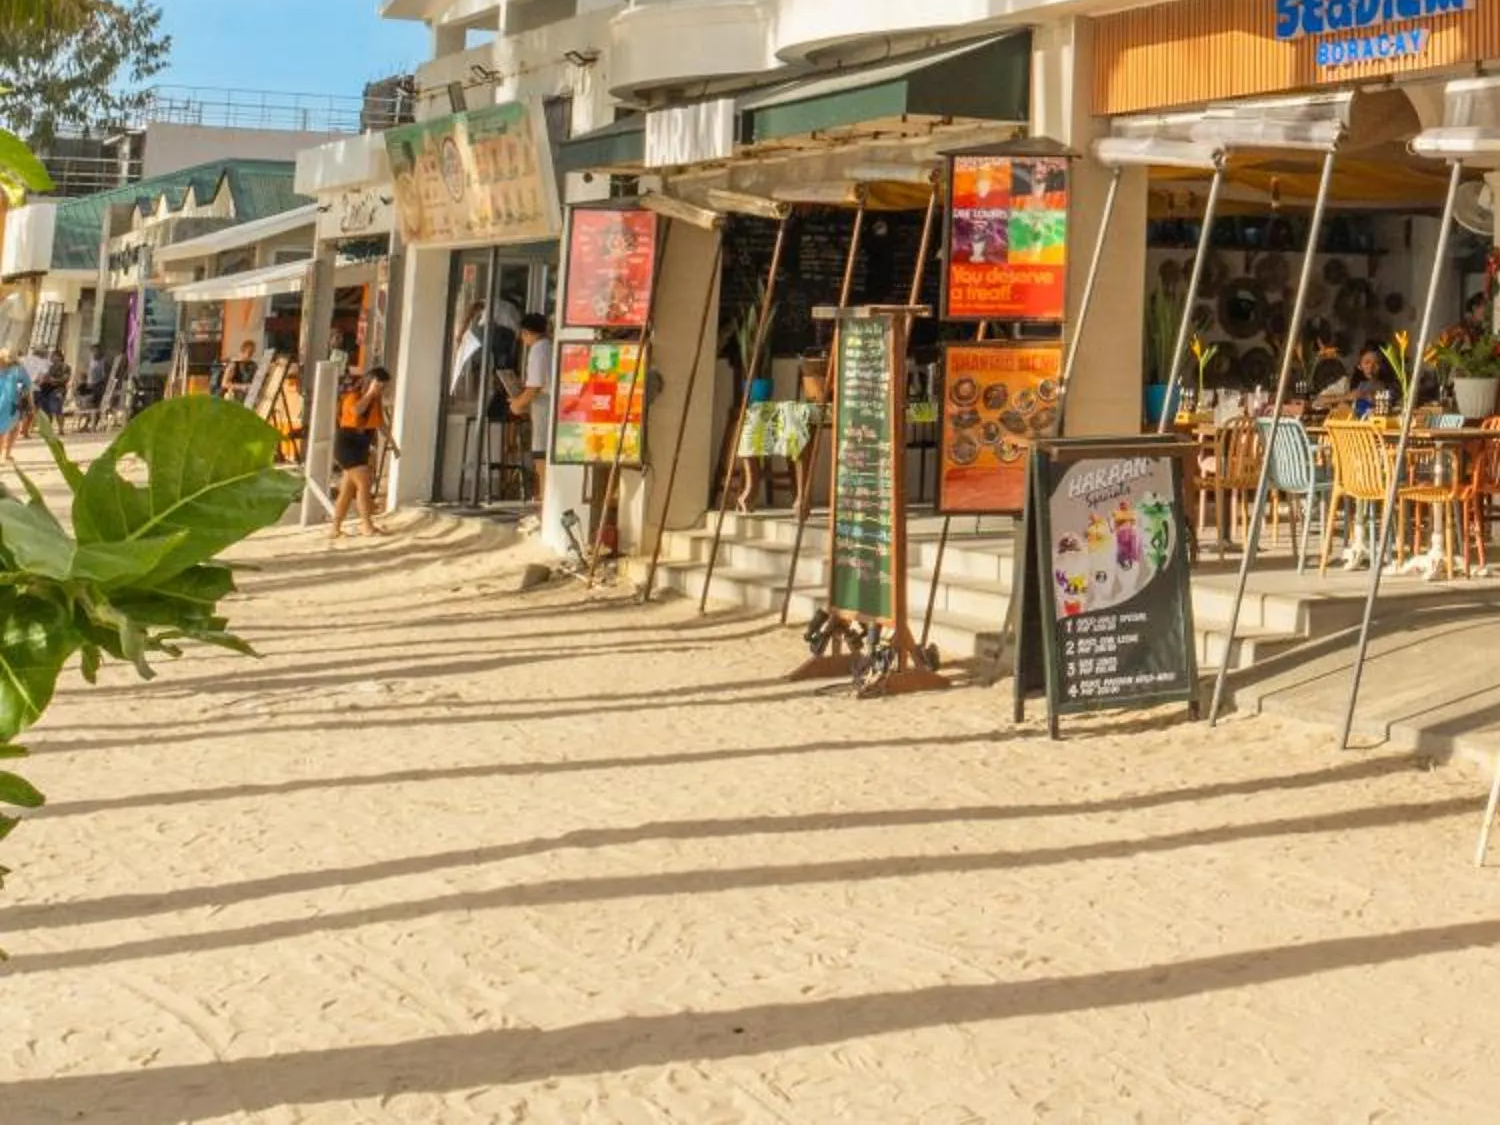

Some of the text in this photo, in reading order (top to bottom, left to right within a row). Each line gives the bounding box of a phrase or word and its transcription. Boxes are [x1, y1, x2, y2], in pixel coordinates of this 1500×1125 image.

[1316, 28, 1424, 66] BORACAY
[952, 266, 1054, 284] You deserve
[951, 287, 963, 300] a
[1066, 619, 1073, 633] 1
[1065, 640, 1075, 655] 2
[1067, 662, 1076, 678] 3
[1068, 683, 1079, 698] 4
